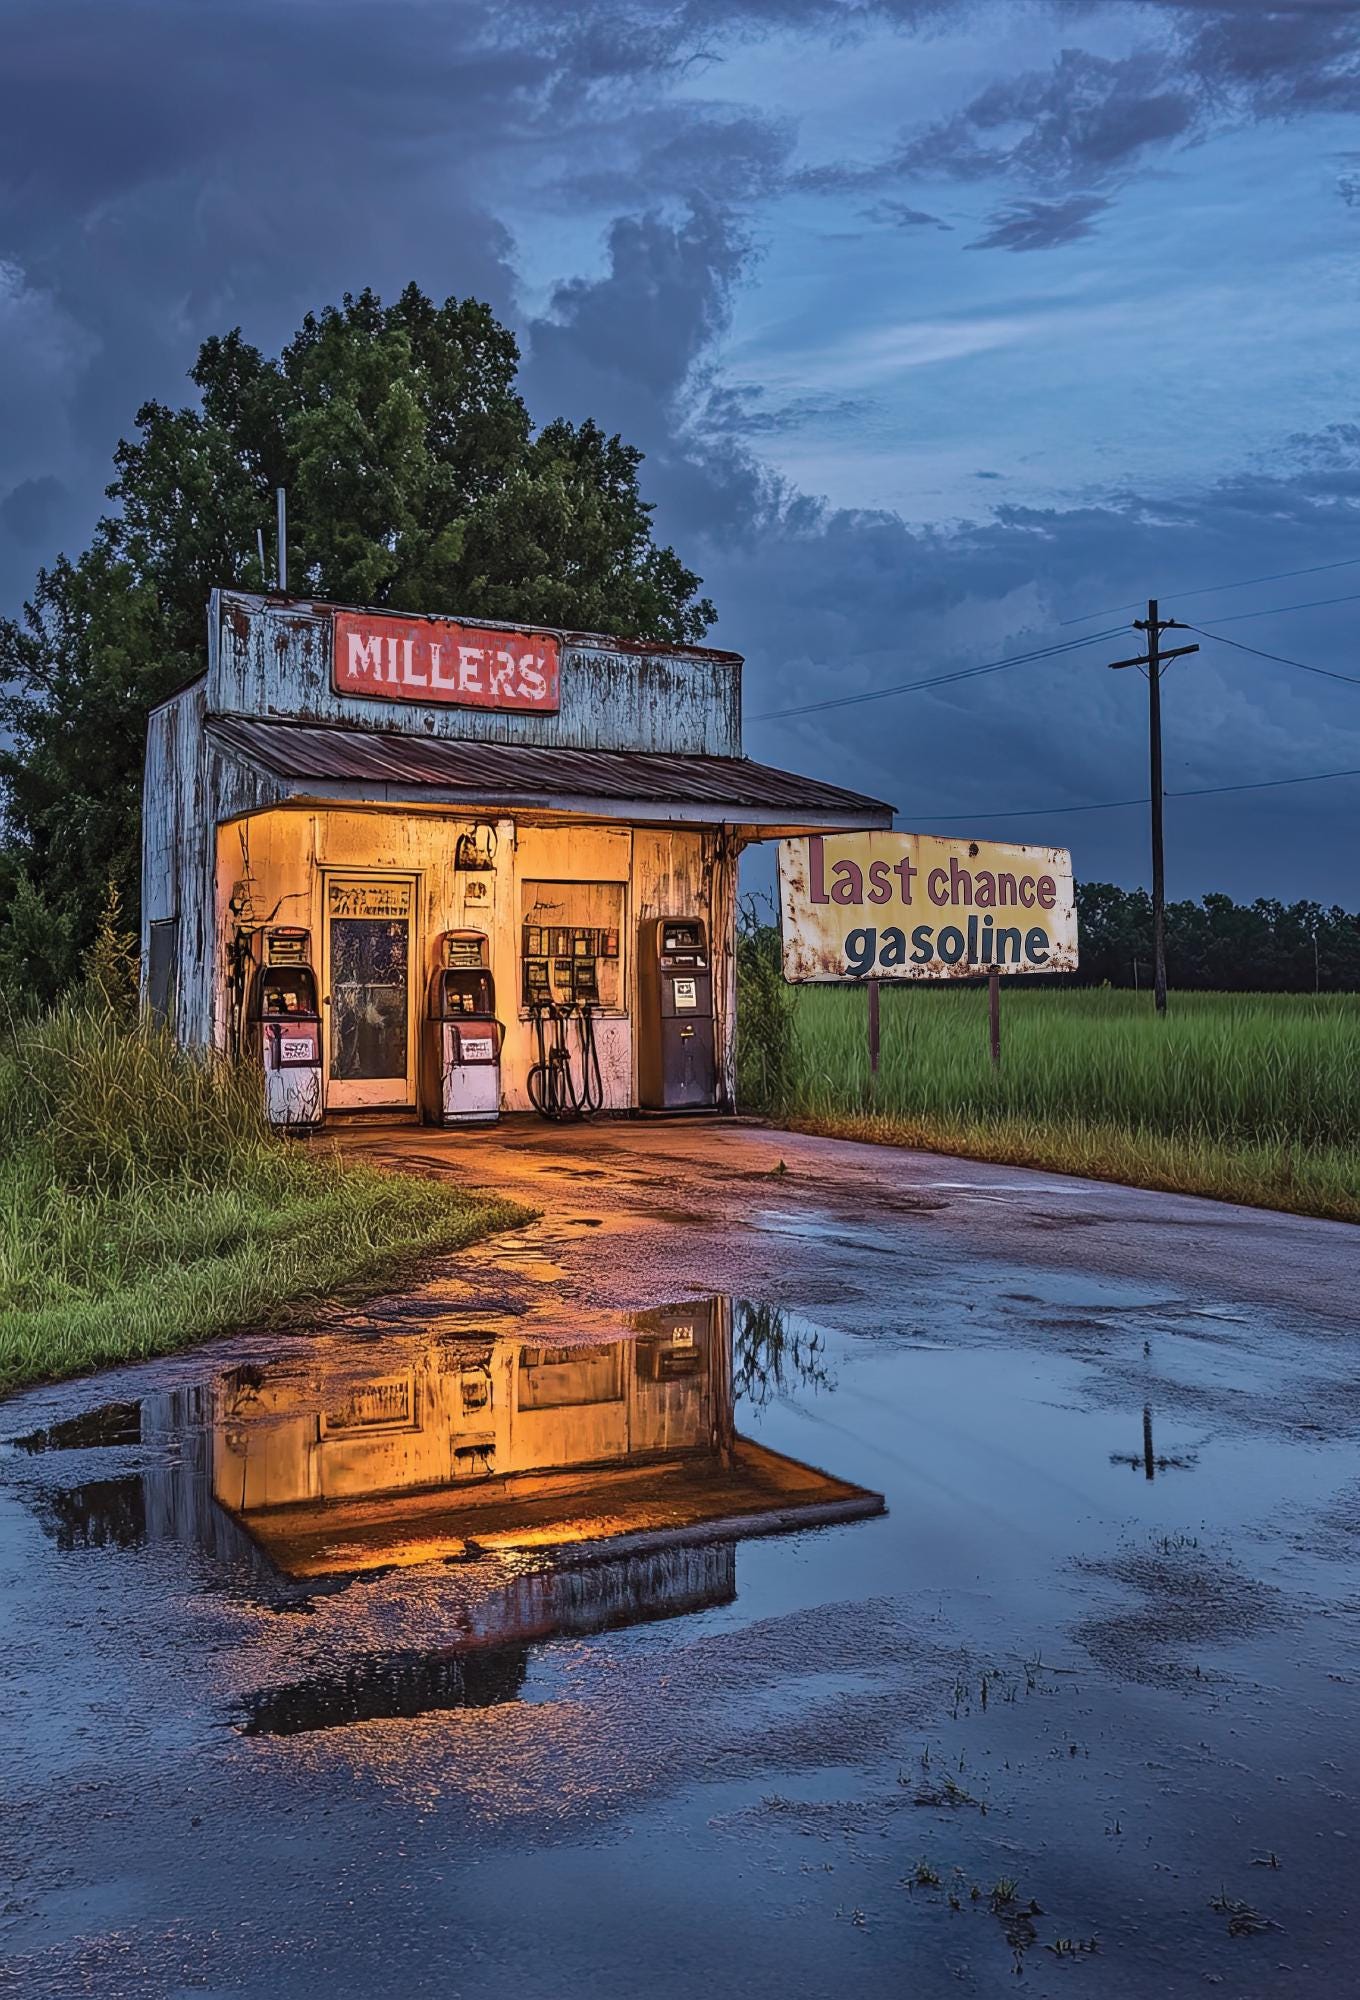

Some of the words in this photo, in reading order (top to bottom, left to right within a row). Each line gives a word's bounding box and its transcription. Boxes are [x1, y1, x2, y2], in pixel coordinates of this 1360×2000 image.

[346, 632, 548, 701] MILLERS
[808, 836, 918, 905] Last
[927, 857, 1057, 910] chance
[844, 914, 1051, 977] gasoline
